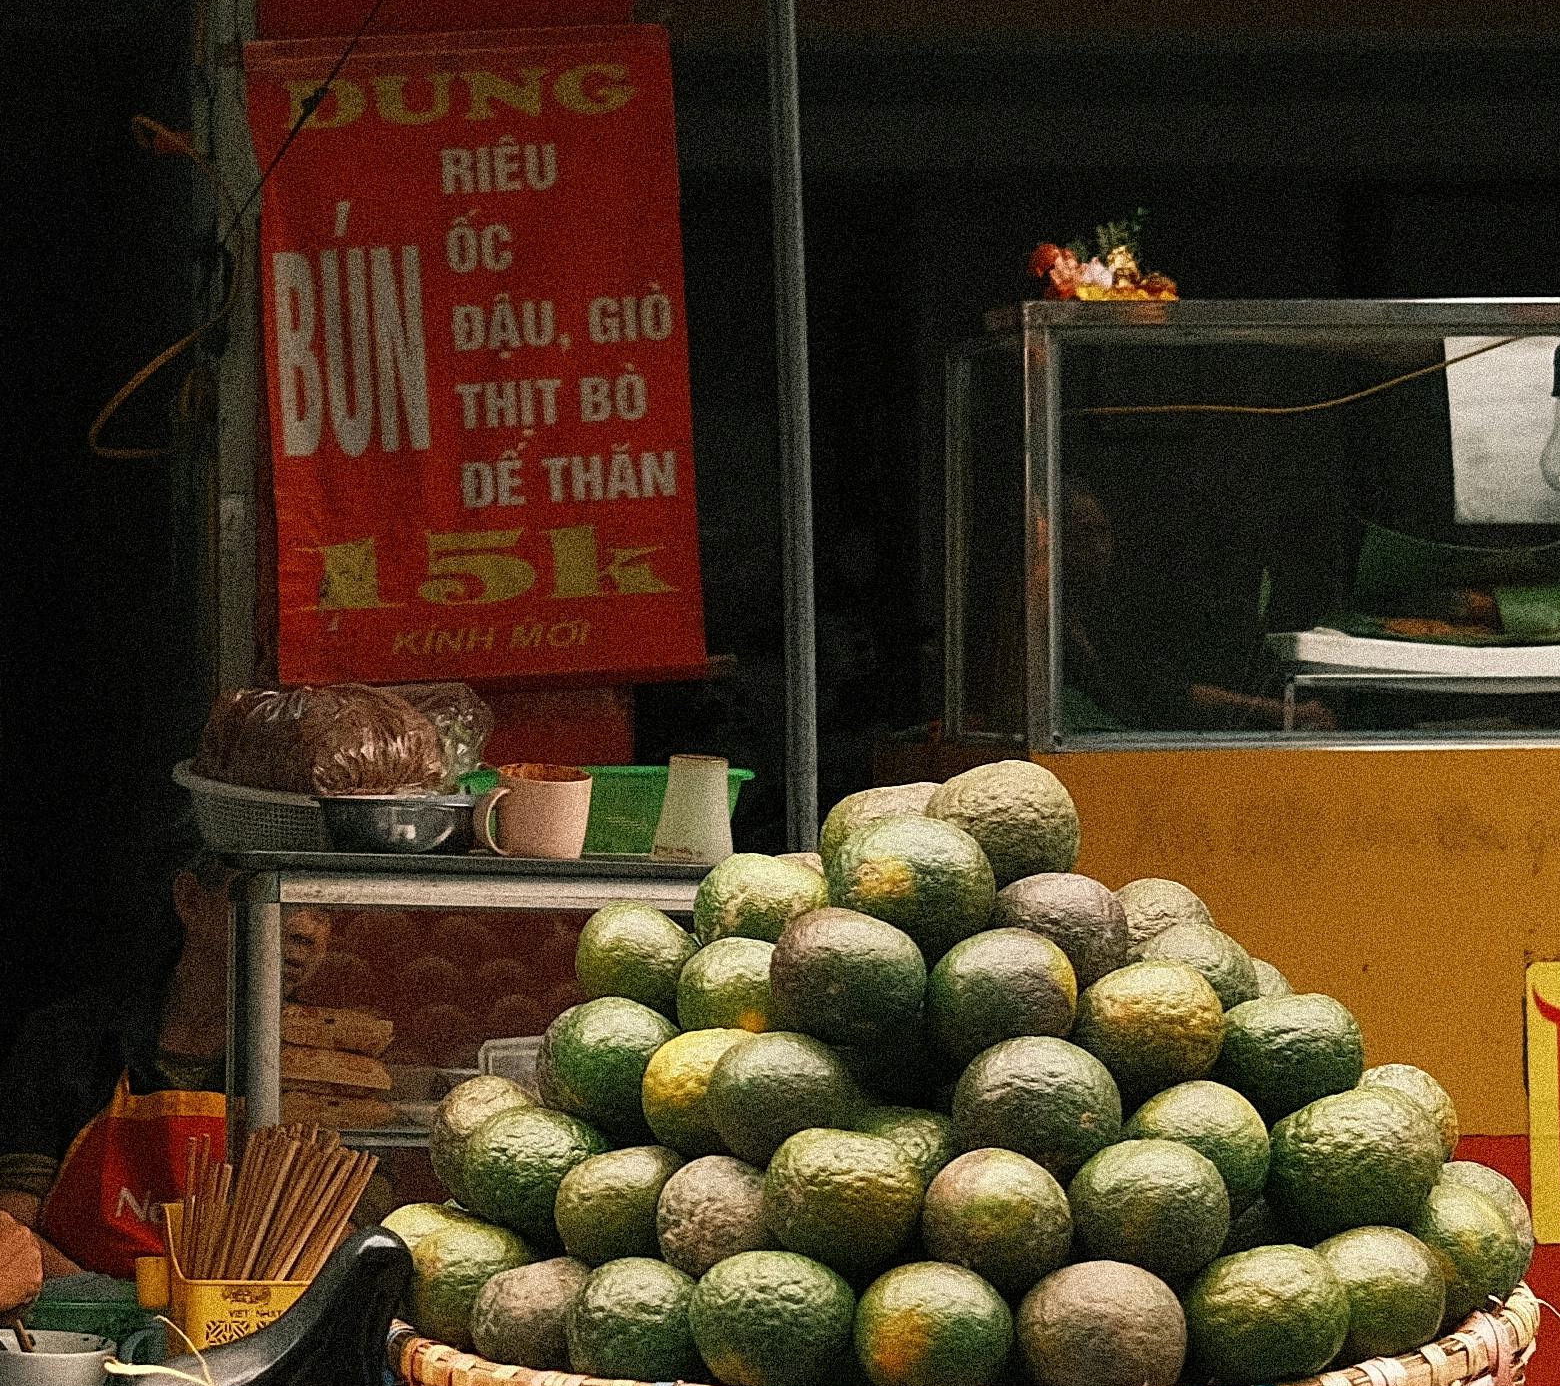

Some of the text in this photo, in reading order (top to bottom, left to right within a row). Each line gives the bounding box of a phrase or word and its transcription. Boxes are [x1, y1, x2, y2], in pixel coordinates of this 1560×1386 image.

[286, 63, 639, 130] DUNG
[441, 135, 559, 195] RIÊU
[446, 208, 513, 273] ỐC
[272, 200, 431, 458] BÚN
[587, 281, 674, 344] GIÒ
[455, 363, 648, 437] THỊT BÒ
[542, 447, 677, 502] THĂN
[284, 524, 679, 612] 15k
[392, 619, 496, 655] KÍNH
